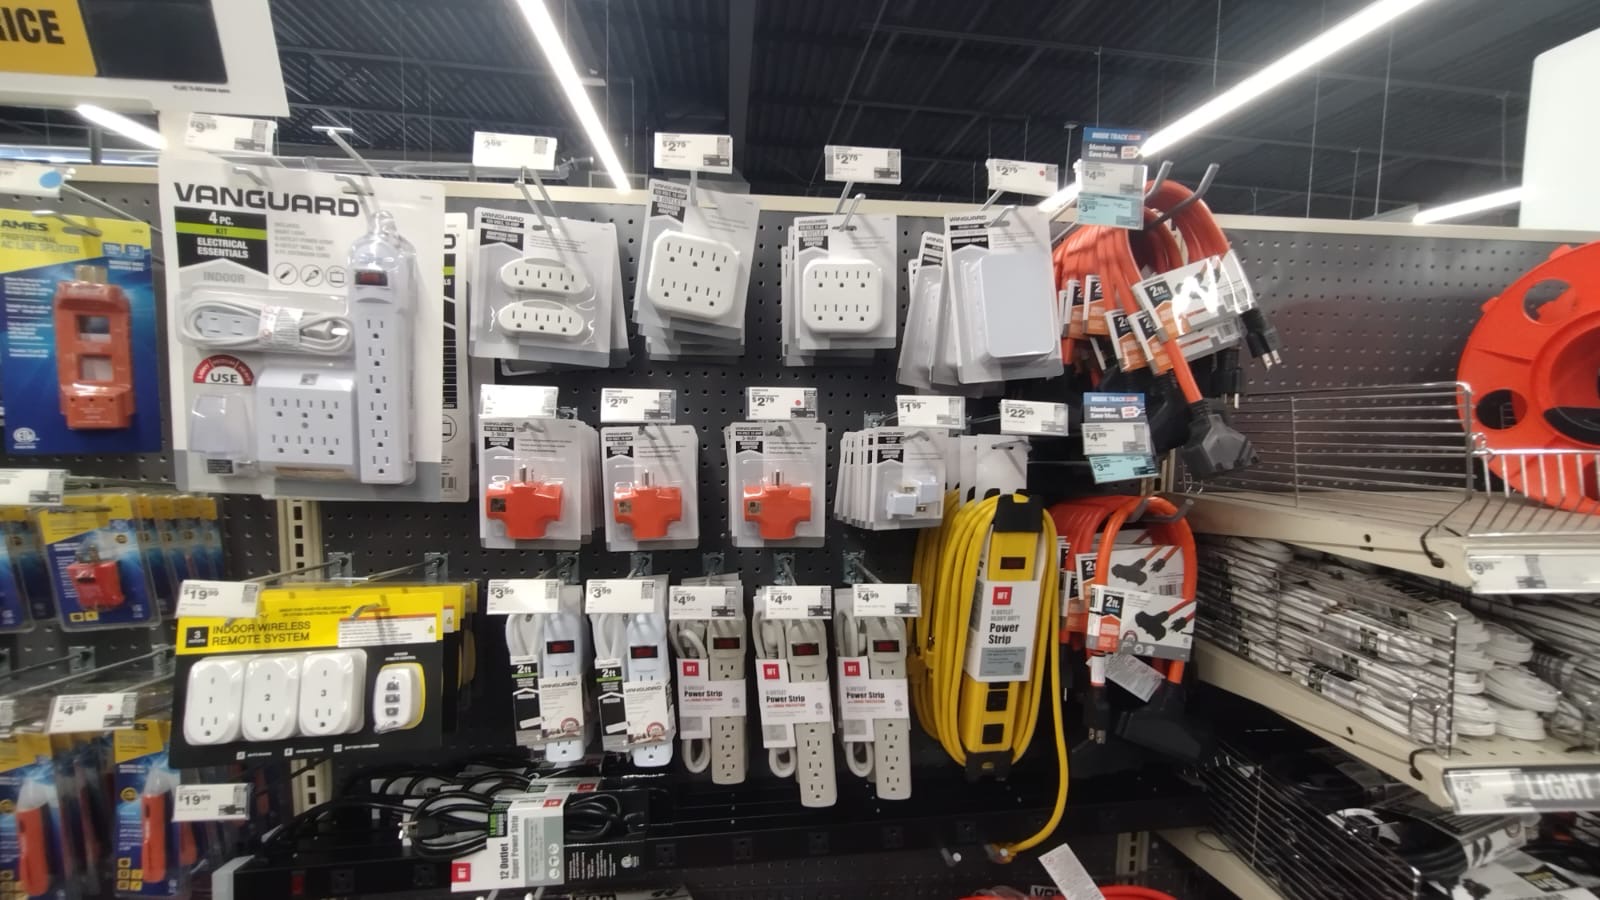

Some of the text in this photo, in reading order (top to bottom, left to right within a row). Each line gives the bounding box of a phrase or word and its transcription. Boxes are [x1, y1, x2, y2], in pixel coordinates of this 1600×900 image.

[0, 7, 65, 45] ICE
[174, 182, 360, 217] VANGUARD
[208, 211, 218, 223] 4
[1, 220, 48, 232] AMES
[215, 227, 228, 235] KIT
[196, 237, 248, 250] ELECTRICAL
[197, 246, 249, 259] ESSENTIALS
[203, 271, 245, 284] INDOOR
[211, 373, 238, 383] USE
[184, 588, 219, 600] $1999
[673, 594, 695, 605] $499
[770, 594, 792, 605] $499
[857, 592, 879, 602] $499
[212, 620, 311, 634] INDOOR WIRELESS
[990, 623, 1019, 633] Power
[194, 630, 201, 638] 3
[212, 634, 260, 646] REMOTE
[264, 631, 310, 643] SYSTEM
[988, 634, 1012, 645] Strip
[517, 665, 532, 674] 2ft
[601, 669, 616, 678] 2ft
[264, 693, 271, 701] 2
[320, 689, 327, 697] 3
[706, 690, 723, 698] Strip
[766, 694, 806, 703] Power Strip
[846, 691, 885, 699] Power Strip
[178, 794, 211, 806] $1999
[511, 834, 519, 857] Power
[499, 843, 509, 880] 12 Outlet
